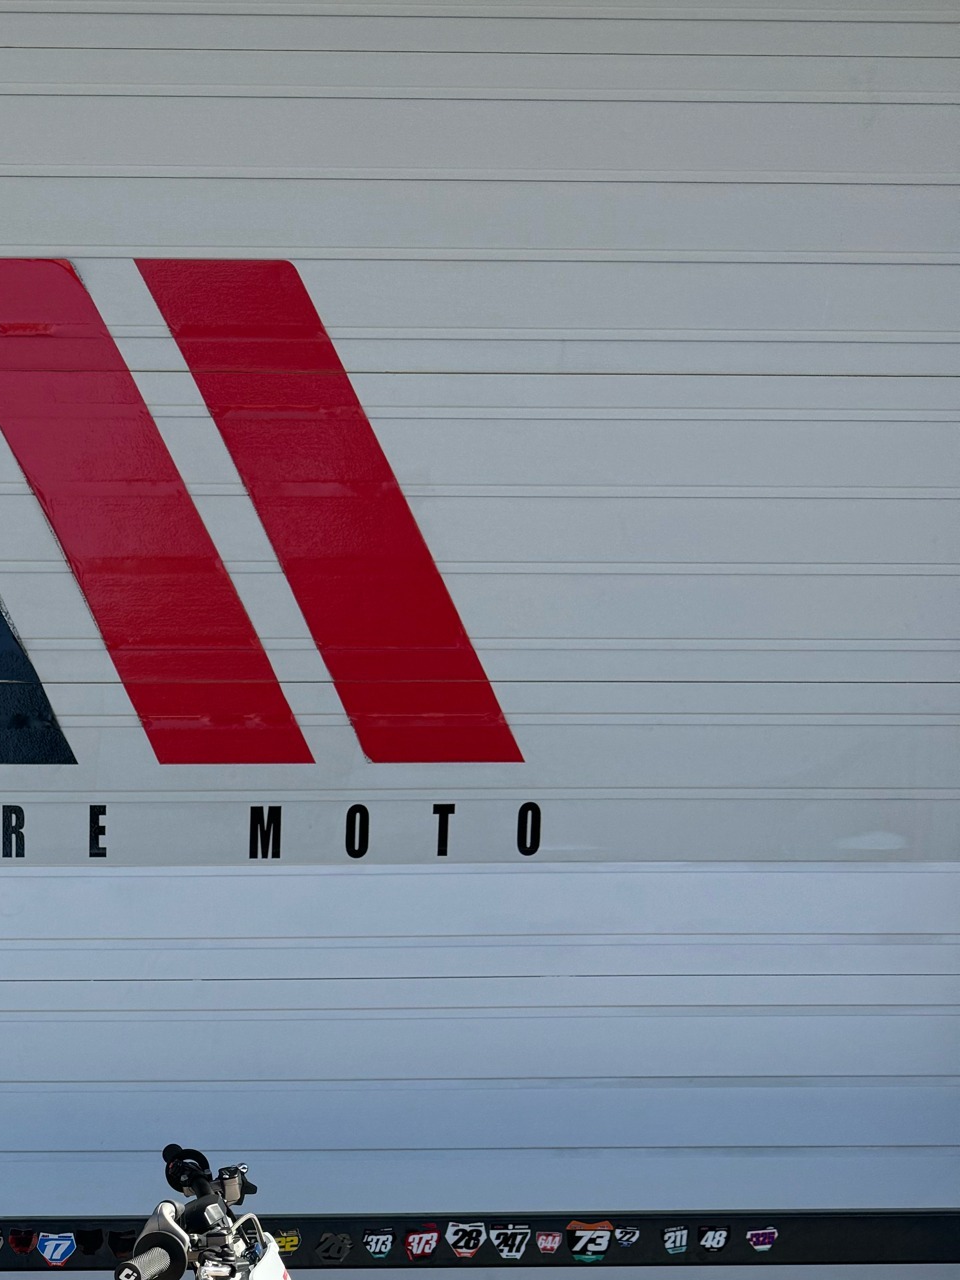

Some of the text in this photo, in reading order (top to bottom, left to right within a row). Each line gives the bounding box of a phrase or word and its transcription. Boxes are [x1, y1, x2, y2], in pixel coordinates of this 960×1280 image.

[248, 802, 542, 859] MOTO
[407, 1232, 439, 1254] 373
[451, 1228, 481, 1250] 28
[495, 1231, 529, 1253] 247
[539, 1235, 560, 1249] 644
[572, 1230, 611, 1252] 73
[618, 1231, 638, 1242] 22
[663, 1229, 688, 1249] 211
[700, 1230, 728, 1248] 48
[44, 1240, 72, 1260] 17
